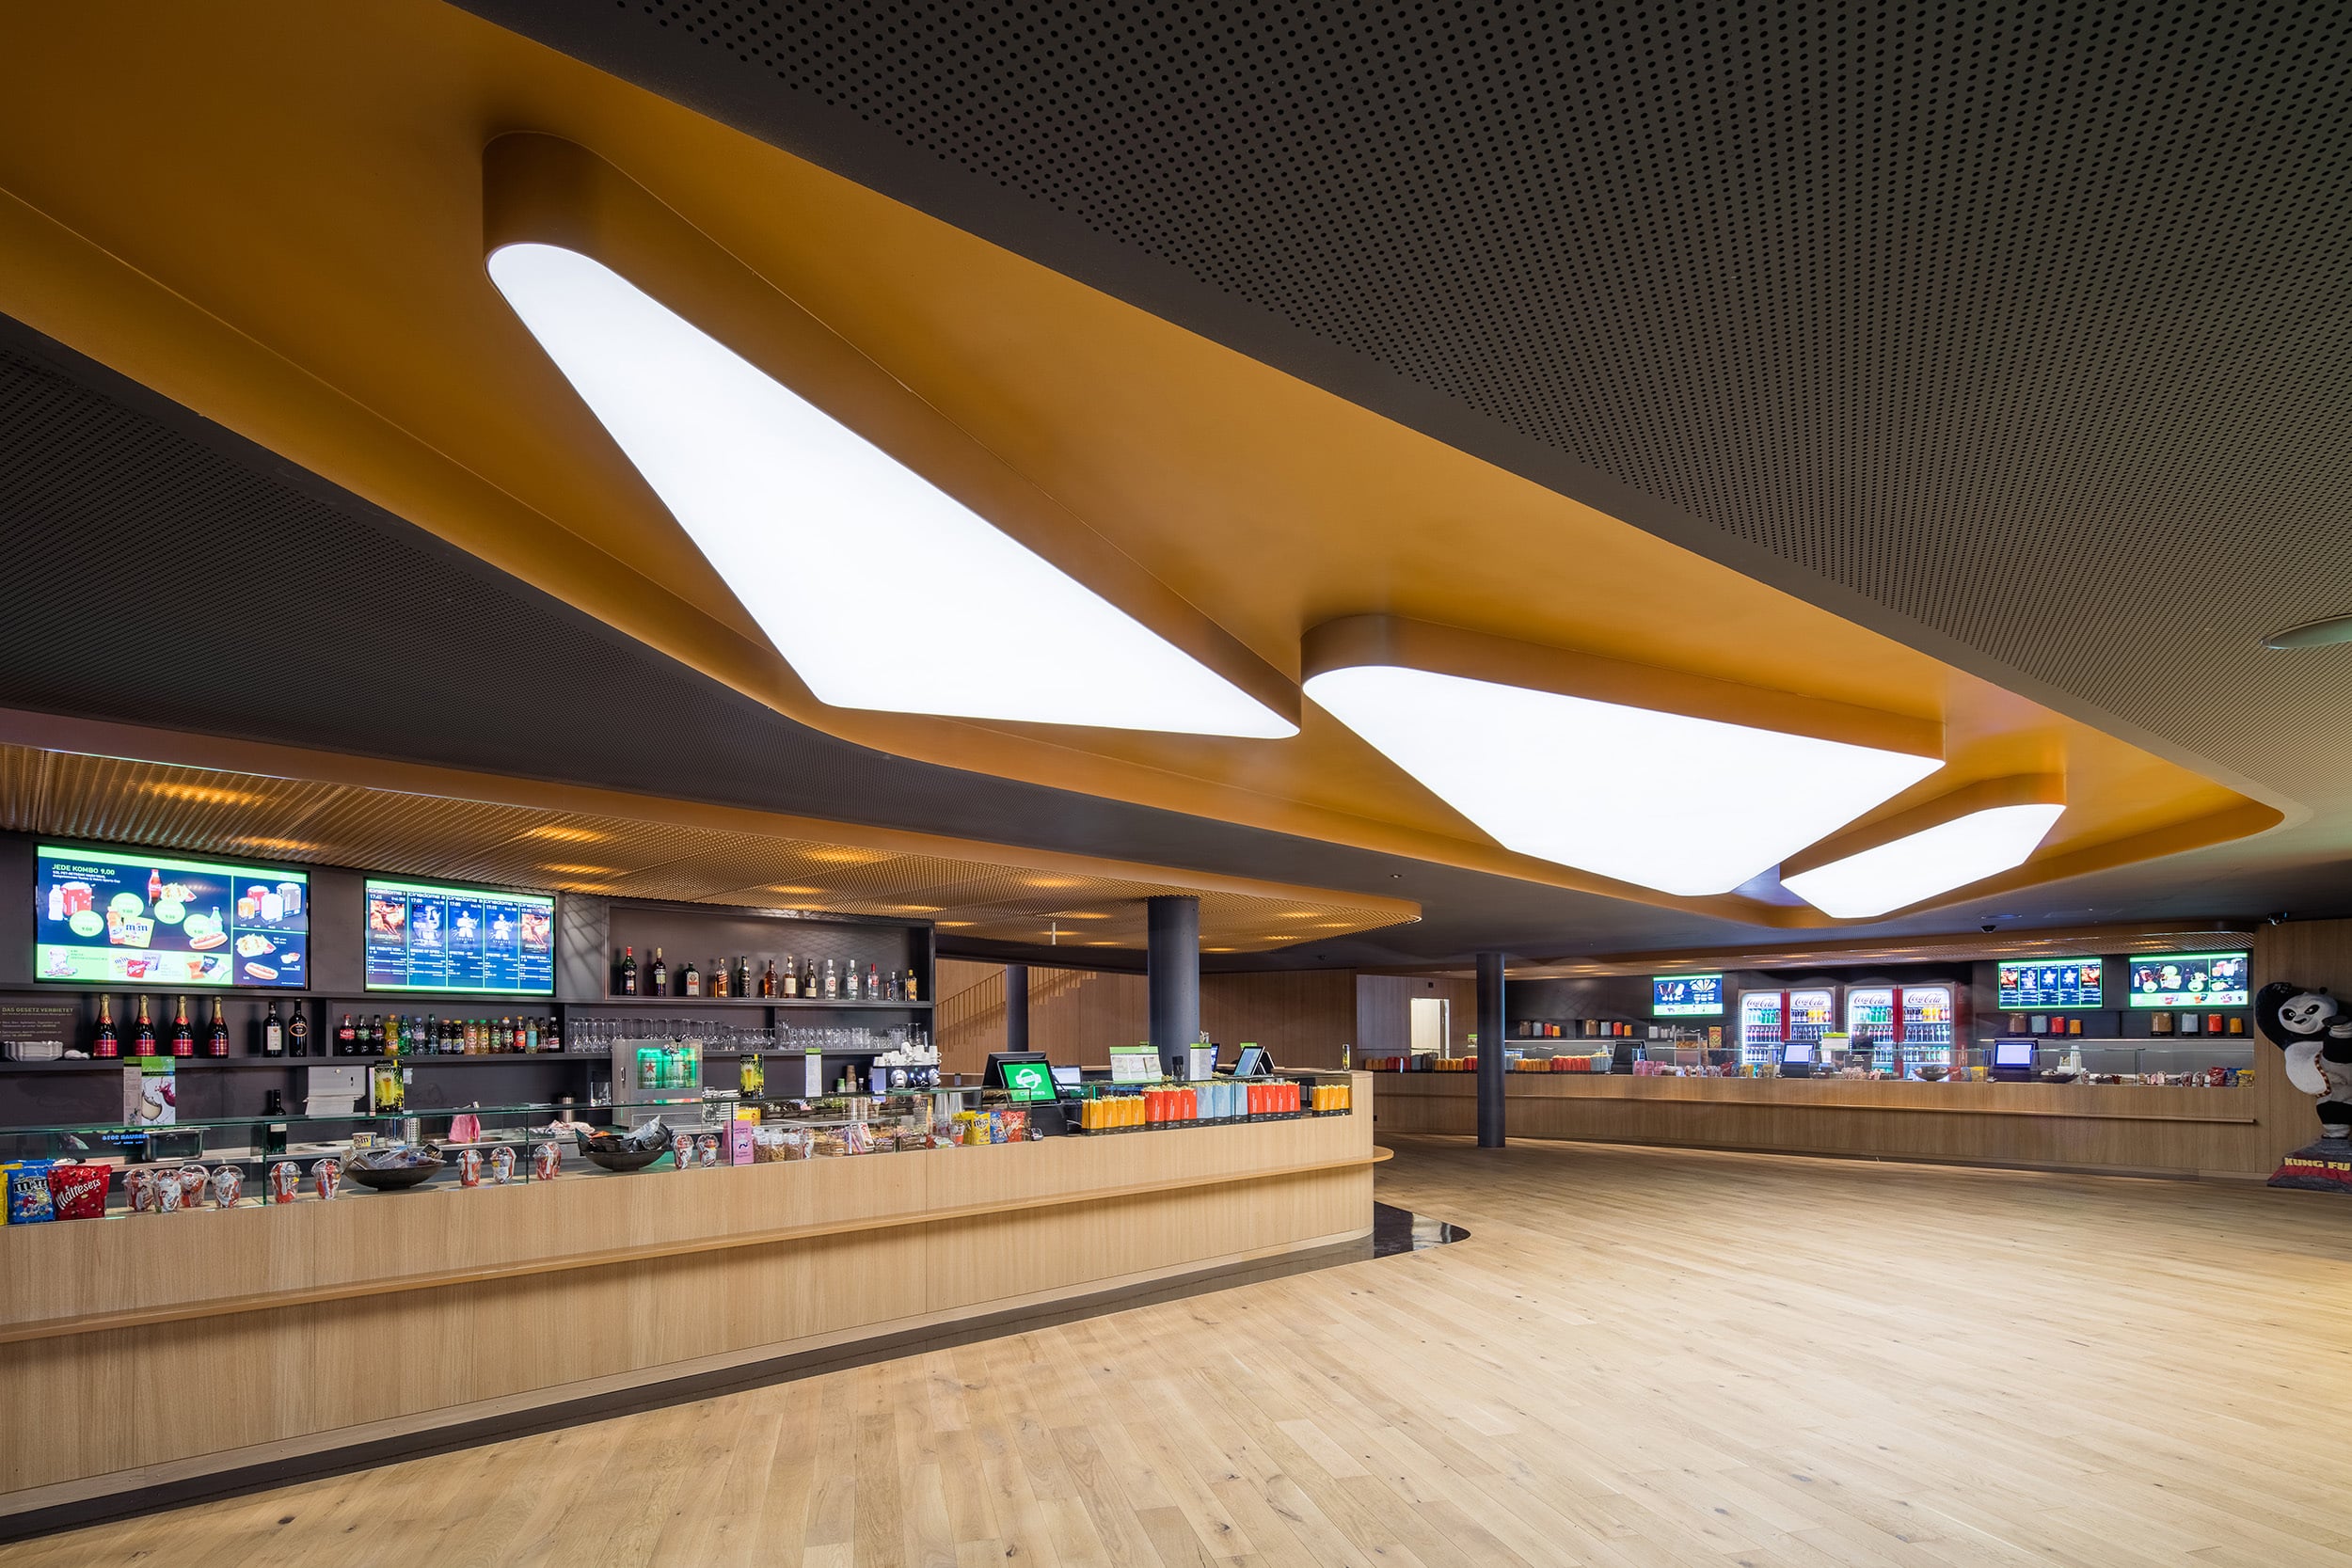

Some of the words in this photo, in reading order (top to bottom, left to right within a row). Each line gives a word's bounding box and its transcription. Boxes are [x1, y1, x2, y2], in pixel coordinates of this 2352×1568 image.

[72, 865, 99, 874] KOMBO
[2284, 1157, 2324, 1167] KUNG
[2327, 1161, 2351, 1171] FU
[56, 1179, 101, 1211] Maltesers
